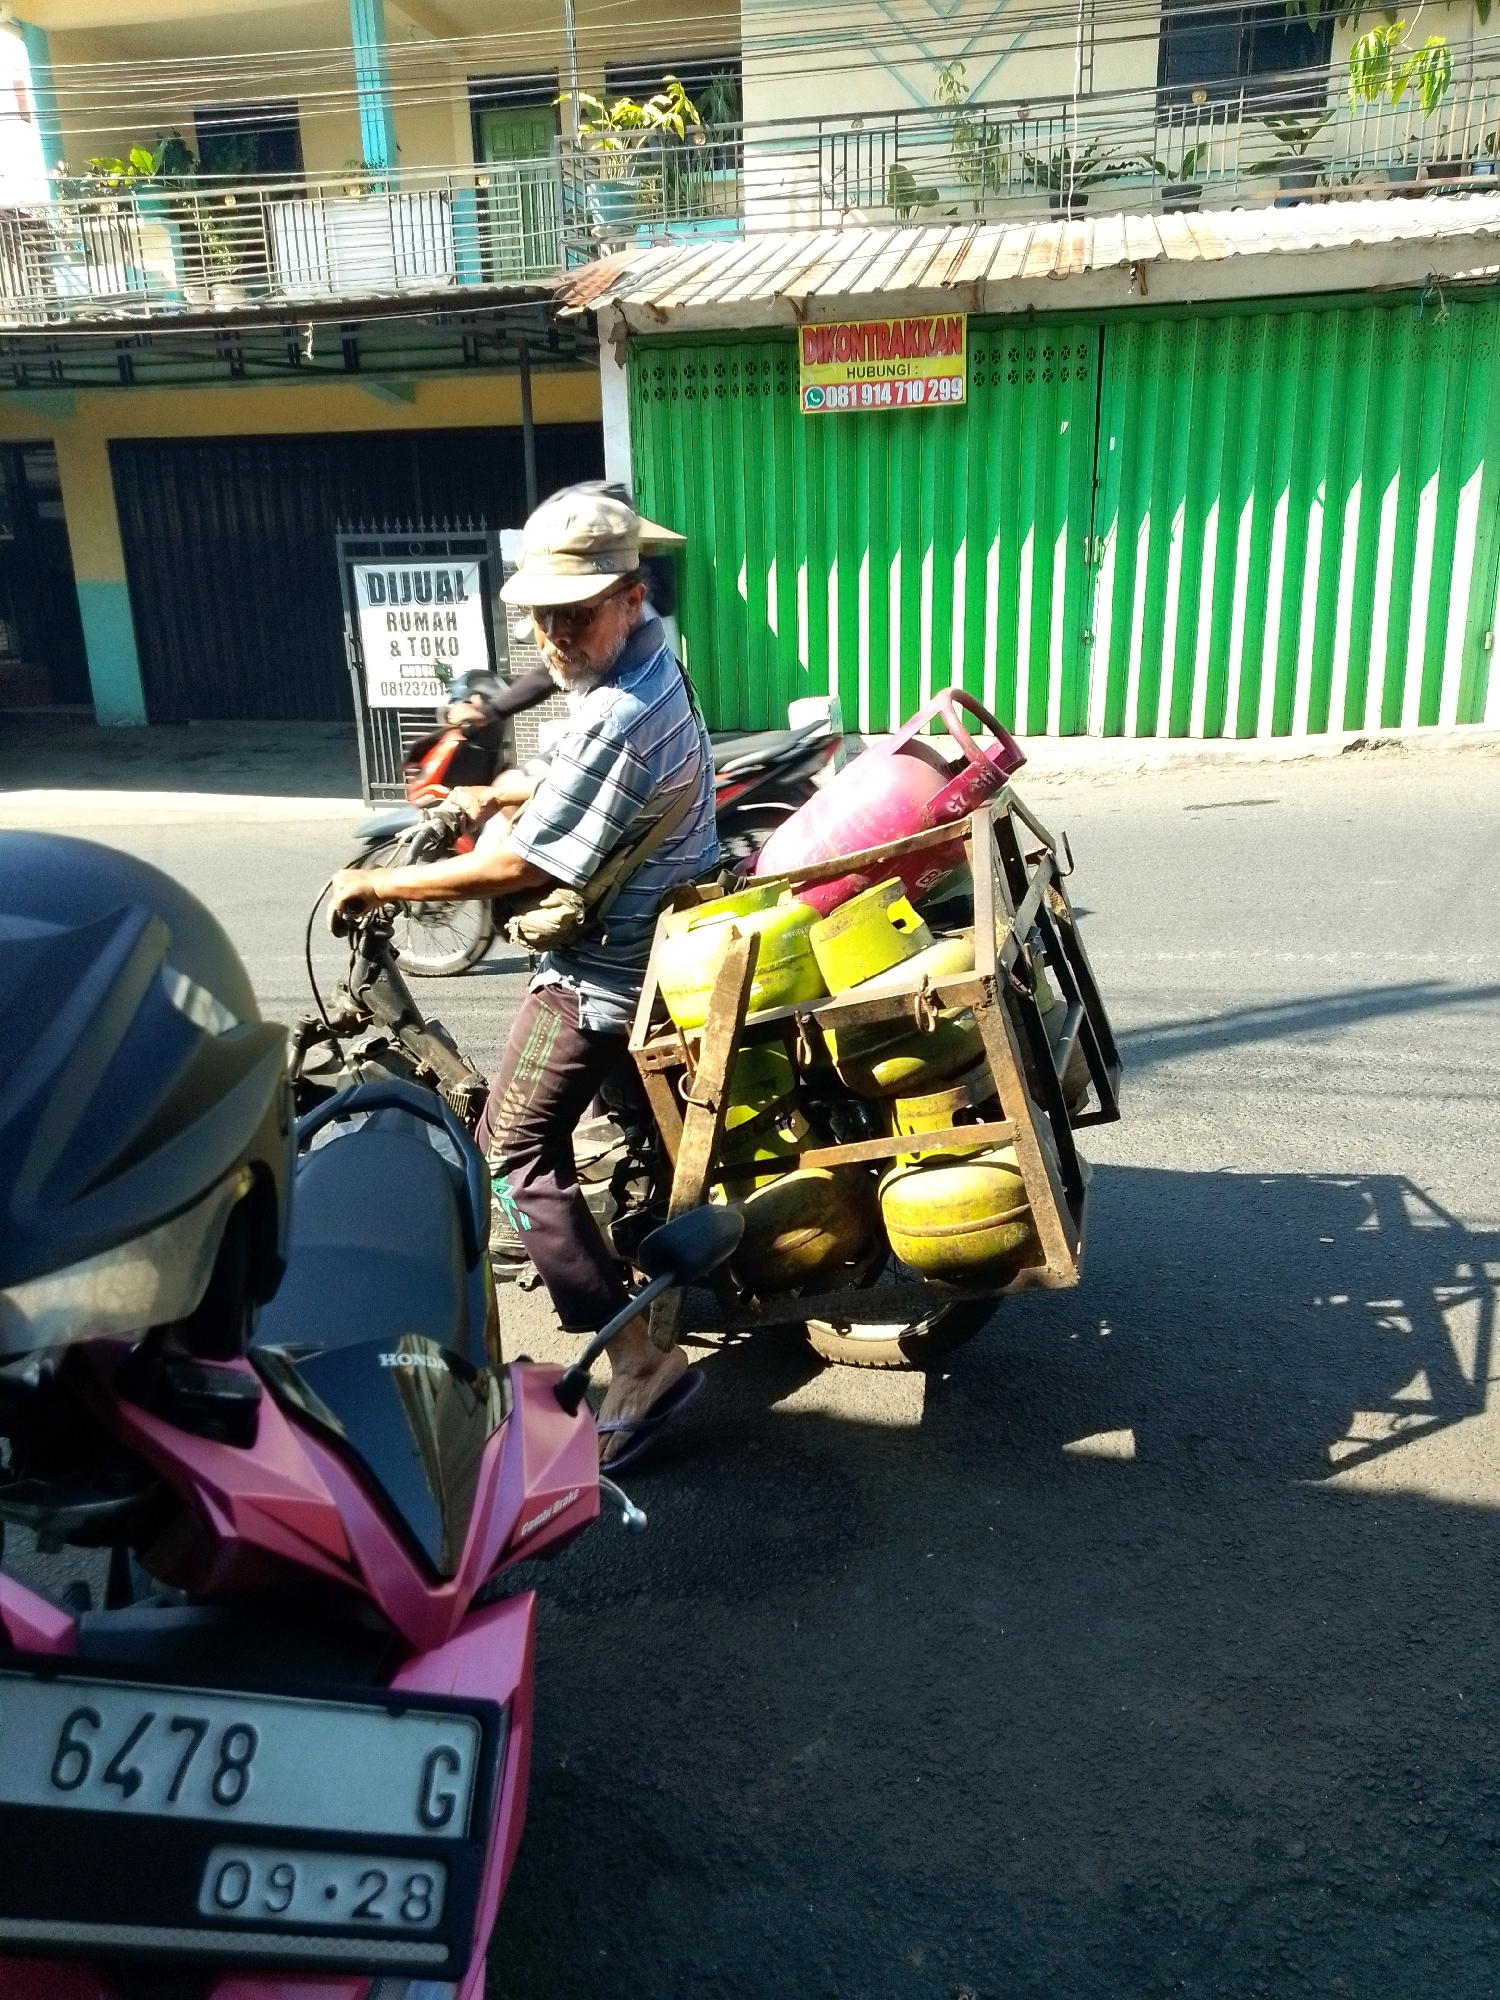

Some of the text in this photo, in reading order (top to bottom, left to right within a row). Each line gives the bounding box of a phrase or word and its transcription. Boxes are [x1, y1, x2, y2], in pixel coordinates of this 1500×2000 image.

[802, 316, 963, 366] DIKONTRAKKAN
[846, 363, 911, 379] HUBUNGI
[825, 377, 963, 408] 081 914 710 299
[365, 569, 470, 606] DIJUAL
[386, 611, 458, 632] RUMAH
[389, 636, 460, 657] & TOKO
[380, 681, 448, 697] 08123201
[378, 1353, 450, 1371] HONDA
[50, 1706, 462, 1829] 6478 G
